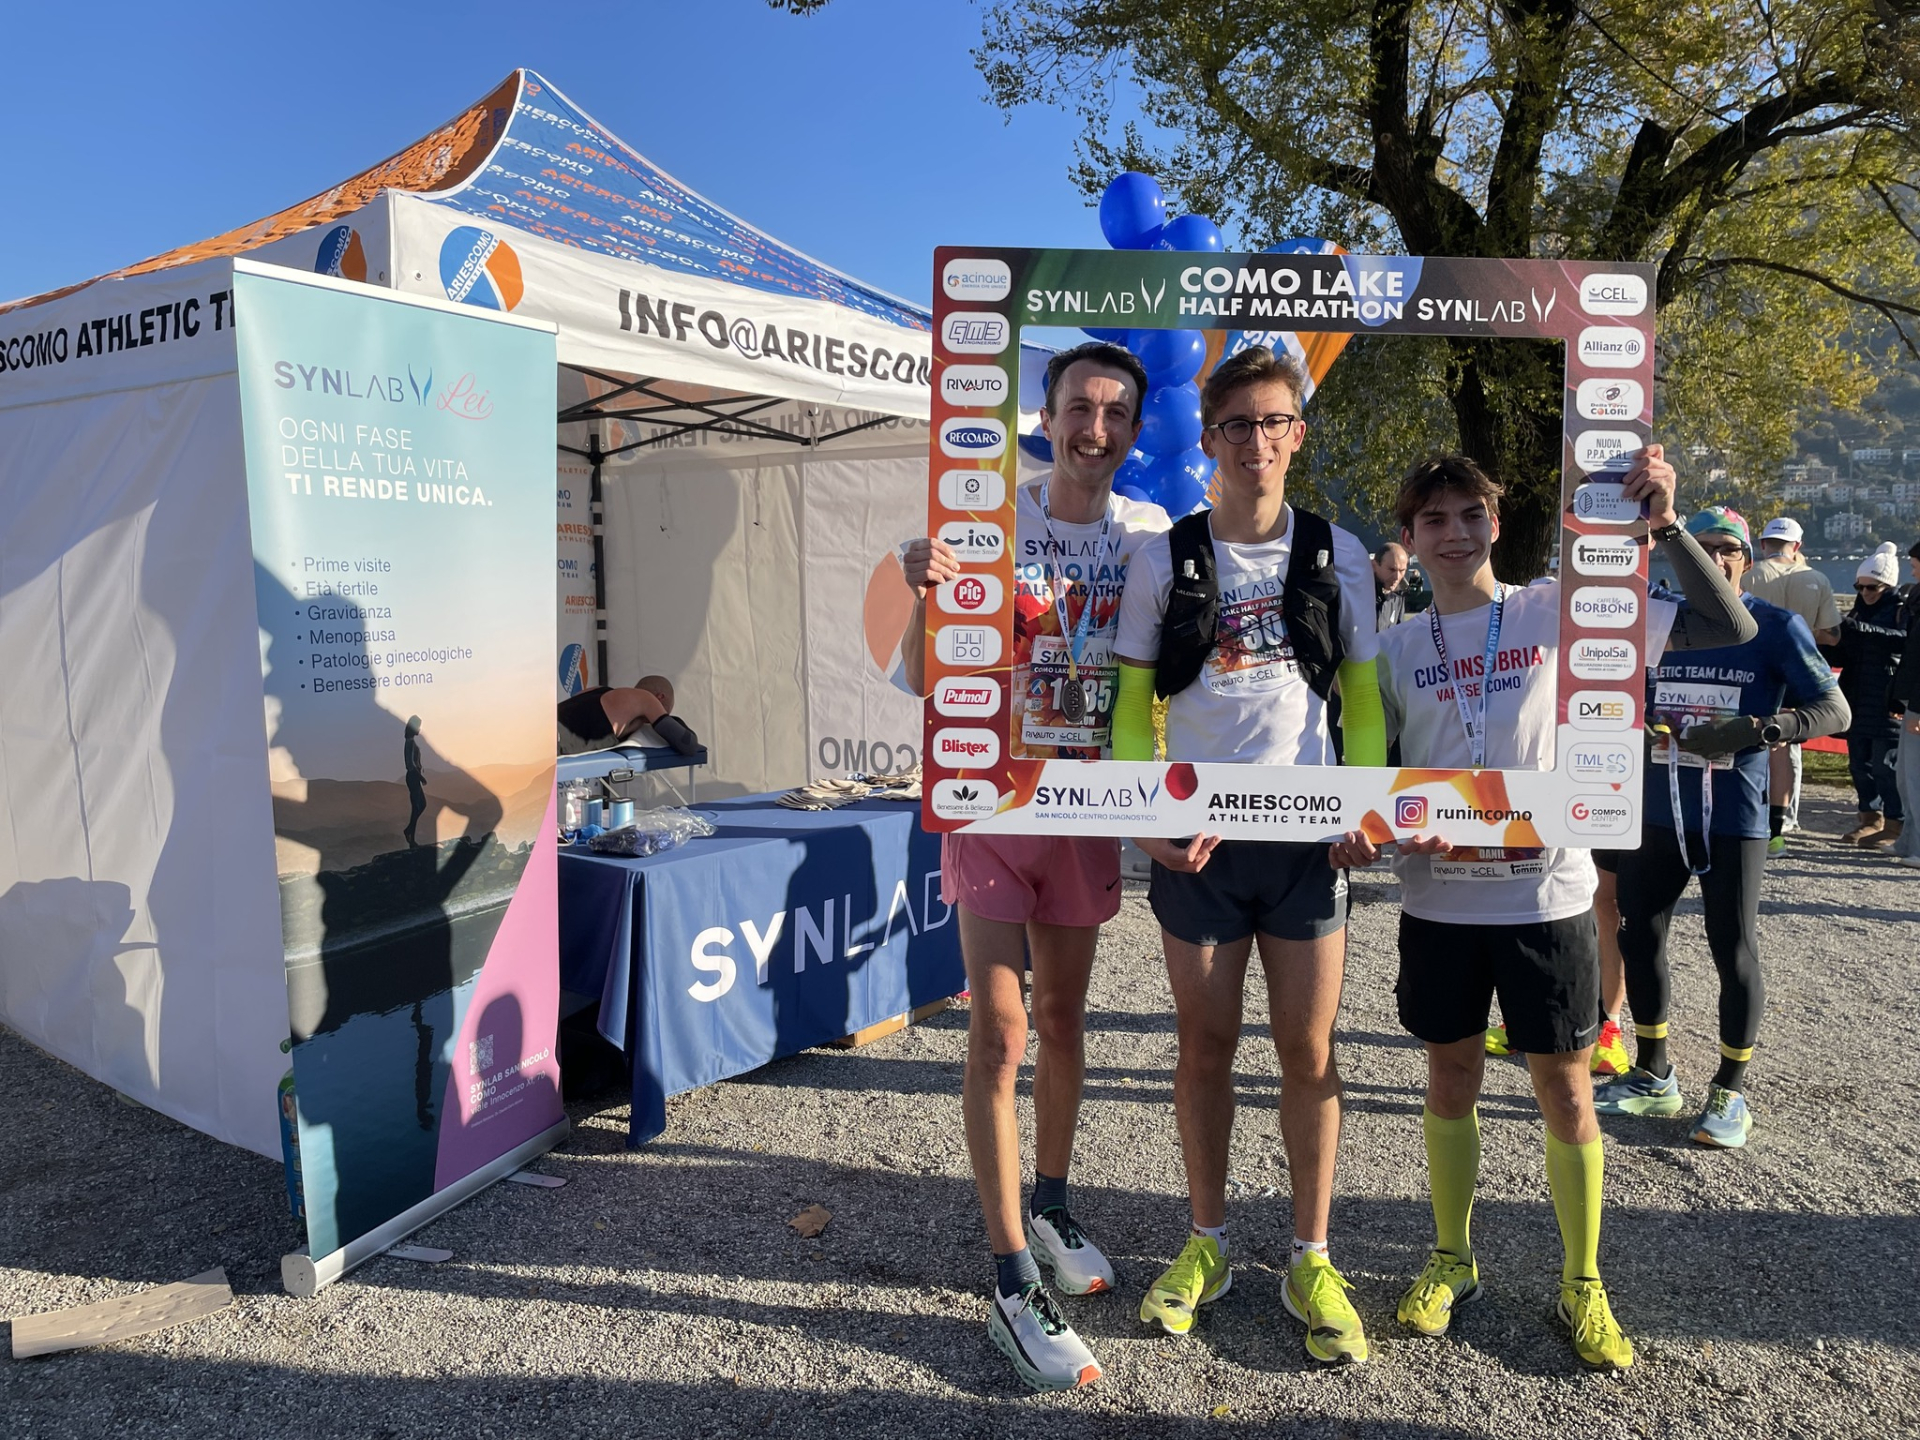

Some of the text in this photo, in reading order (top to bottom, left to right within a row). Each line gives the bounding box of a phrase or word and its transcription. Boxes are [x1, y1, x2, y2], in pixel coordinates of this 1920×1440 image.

[446, 231, 492, 300] ARIESCOMO
[961, 272, 1007, 284] acinque
[1180, 266, 1404, 298] COMO LAKE
[1026, 290, 1136, 314] SYNLAB
[1600, 286, 1629, 300] CEL
[1180, 297, 1404, 320] HALF MARATHON
[1417, 297, 1526, 323] SYNLAB
[75, 297, 201, 359] ATHLETIC
[1583, 340, 1623, 352] Allianz
[273, 360, 405, 403] SYNLAB
[946, 378, 1003, 392] RIVAUTO
[278, 416, 413, 451] OGNI FASE
[949, 432, 1000, 444] RECOARO
[1595, 438, 1622, 449] NUOVA
[281, 445, 469, 481] DELLA TUA VITA
[284, 472, 493, 507] TI RENDE UNICA.
[967, 528, 1000, 548] ico
[303, 556, 392, 573] Prime visite
[1577, 544, 1634, 566] tommy
[305, 580, 379, 597] Età fertile
[307, 604, 393, 621] Gravidanza
[1240, 603, 1260, 613] HALF
[1574, 600, 1634, 614] BORBONE
[309, 628, 396, 649] Menopausa
[310, 645, 474, 673] Patologie ginecologiche
[1241, 646, 1295, 666] FRANCESCO
[1580, 646, 1629, 662] UnipolSai
[1033, 666, 1054, 674] COMO
[1685, 665, 1756, 684] TEAM LARIO
[312, 670, 434, 694] Benessere donna
[1486, 675, 1522, 694] COMO
[945, 690, 989, 704] Pulmoll
[1658, 692, 1717, 706] SYNLAB
[1025, 730, 1056, 739] RIVAUTO
[941, 738, 990, 757] Blistex
[1574, 753, 1604, 766] TML
[1035, 786, 1133, 808] SYNLAB
[1207, 793, 1343, 813] ARIESCOMO
[936, 803, 964, 812] Benessere
[970, 803, 994, 811] Bellezza
[1050, 812, 1078, 820] NICOLÒ
[1109, 814, 1157, 822] DIAGNOSTICO
[1436, 804, 1533, 822] runincomo
[1591, 808, 1627, 817] COMPOS
[1208, 813, 1342, 825] ATHLETIC TEAM
[1433, 866, 1467, 876] RIVAUTO
[1509, 862, 1544, 876] tommy
[469, 1047, 550, 1094] SYNLAB SAN NICOLÒ
[469, 1085, 497, 1104] COMO
[470, 1100, 489, 1115] viale
[490, 1082, 525, 1106] Innocenzo
